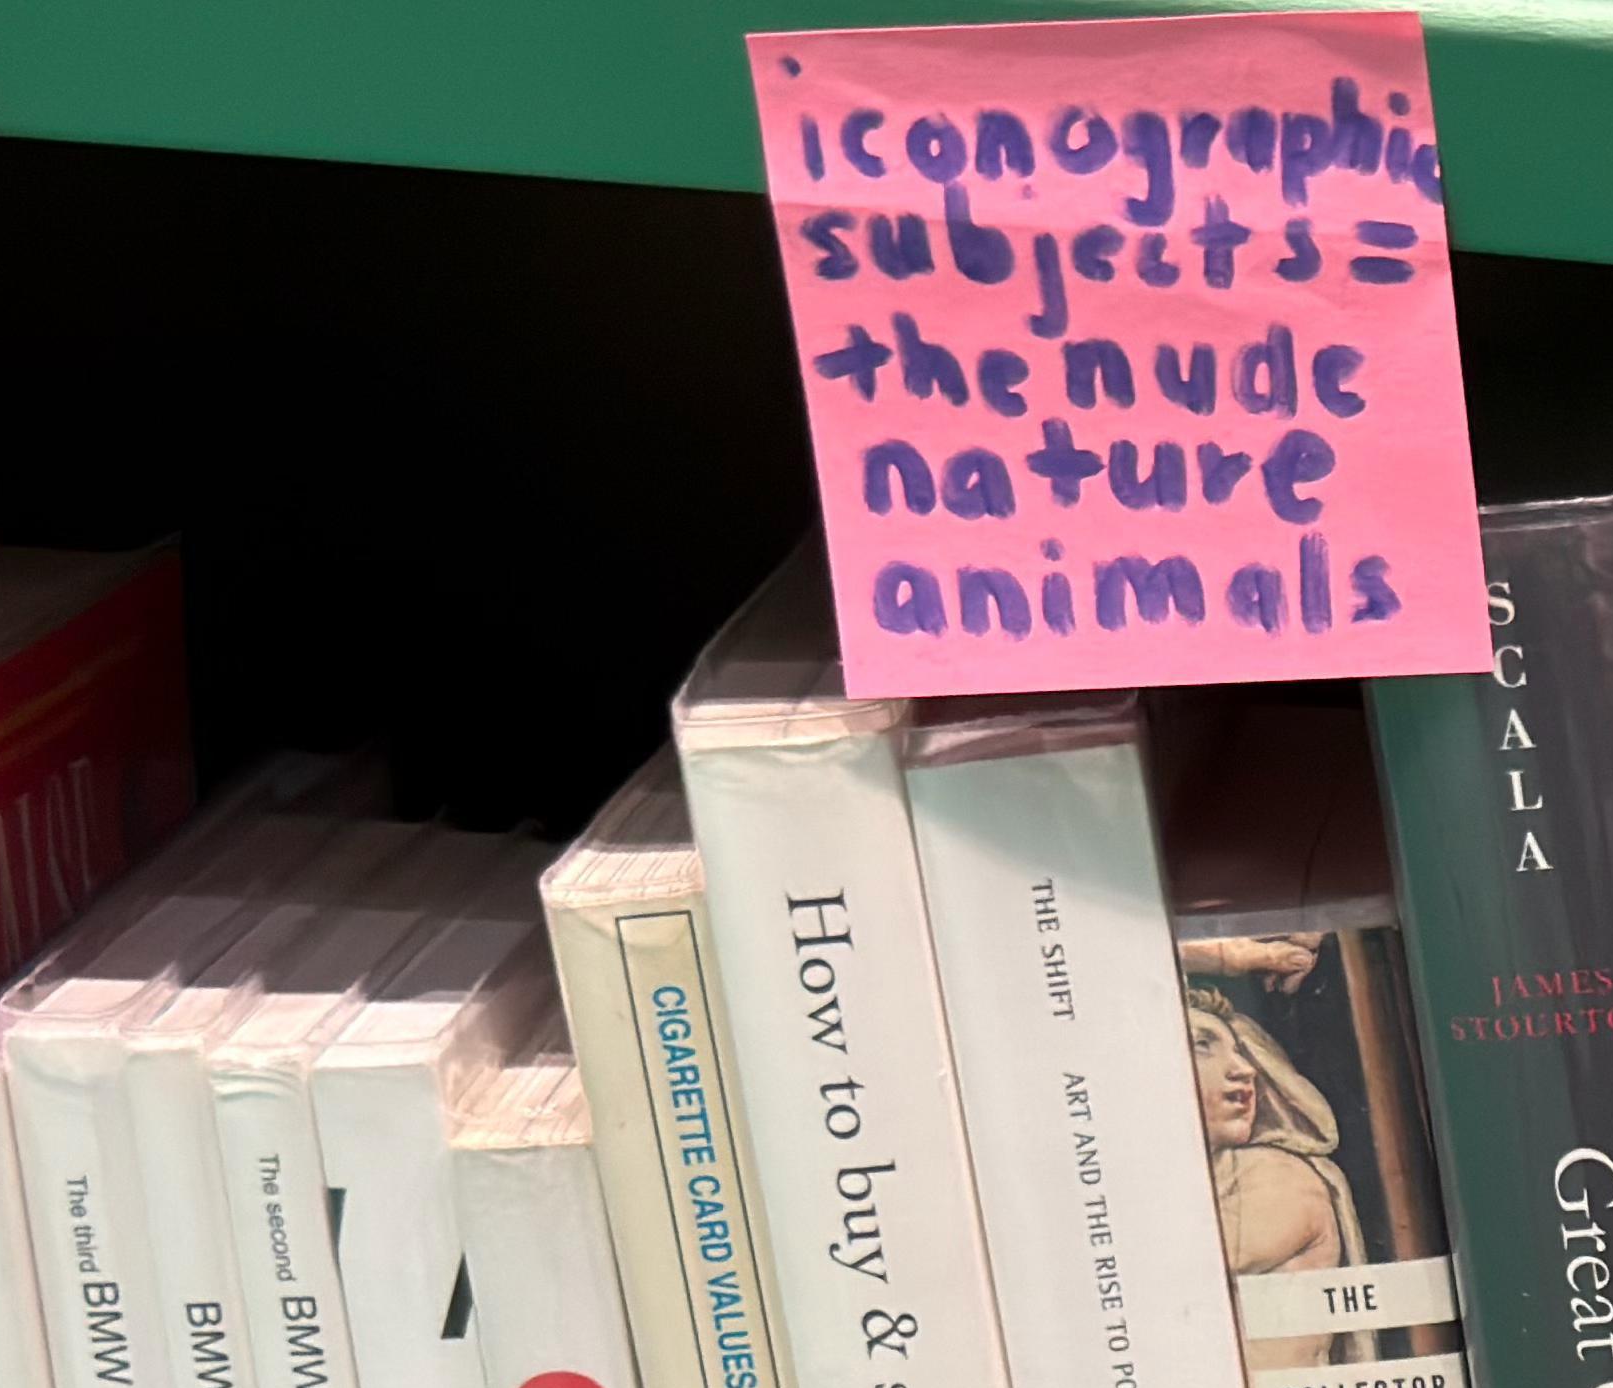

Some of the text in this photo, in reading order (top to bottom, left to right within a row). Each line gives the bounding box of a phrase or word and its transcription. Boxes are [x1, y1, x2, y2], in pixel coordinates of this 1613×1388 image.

[813, 312, 1366, 419] the nude
[863, 418, 1335, 524] nature
[872, 531, 1402, 641] animals
[786, 889, 853, 1055] How
[1491, 971, 1613, 1004] JAMES
[651, 984, 716, 1167] CIGARETTE
[687, 1174, 733, 1264] CARD
[819, 1073, 866, 1141] to
[259, 1155, 280, 1194] The
[265, 1201, 296, 1282] second
[829, 1159, 897, 1287] buy
[860, 1307, 920, 1361] &
[1323, 1285, 1377, 1315] THE
